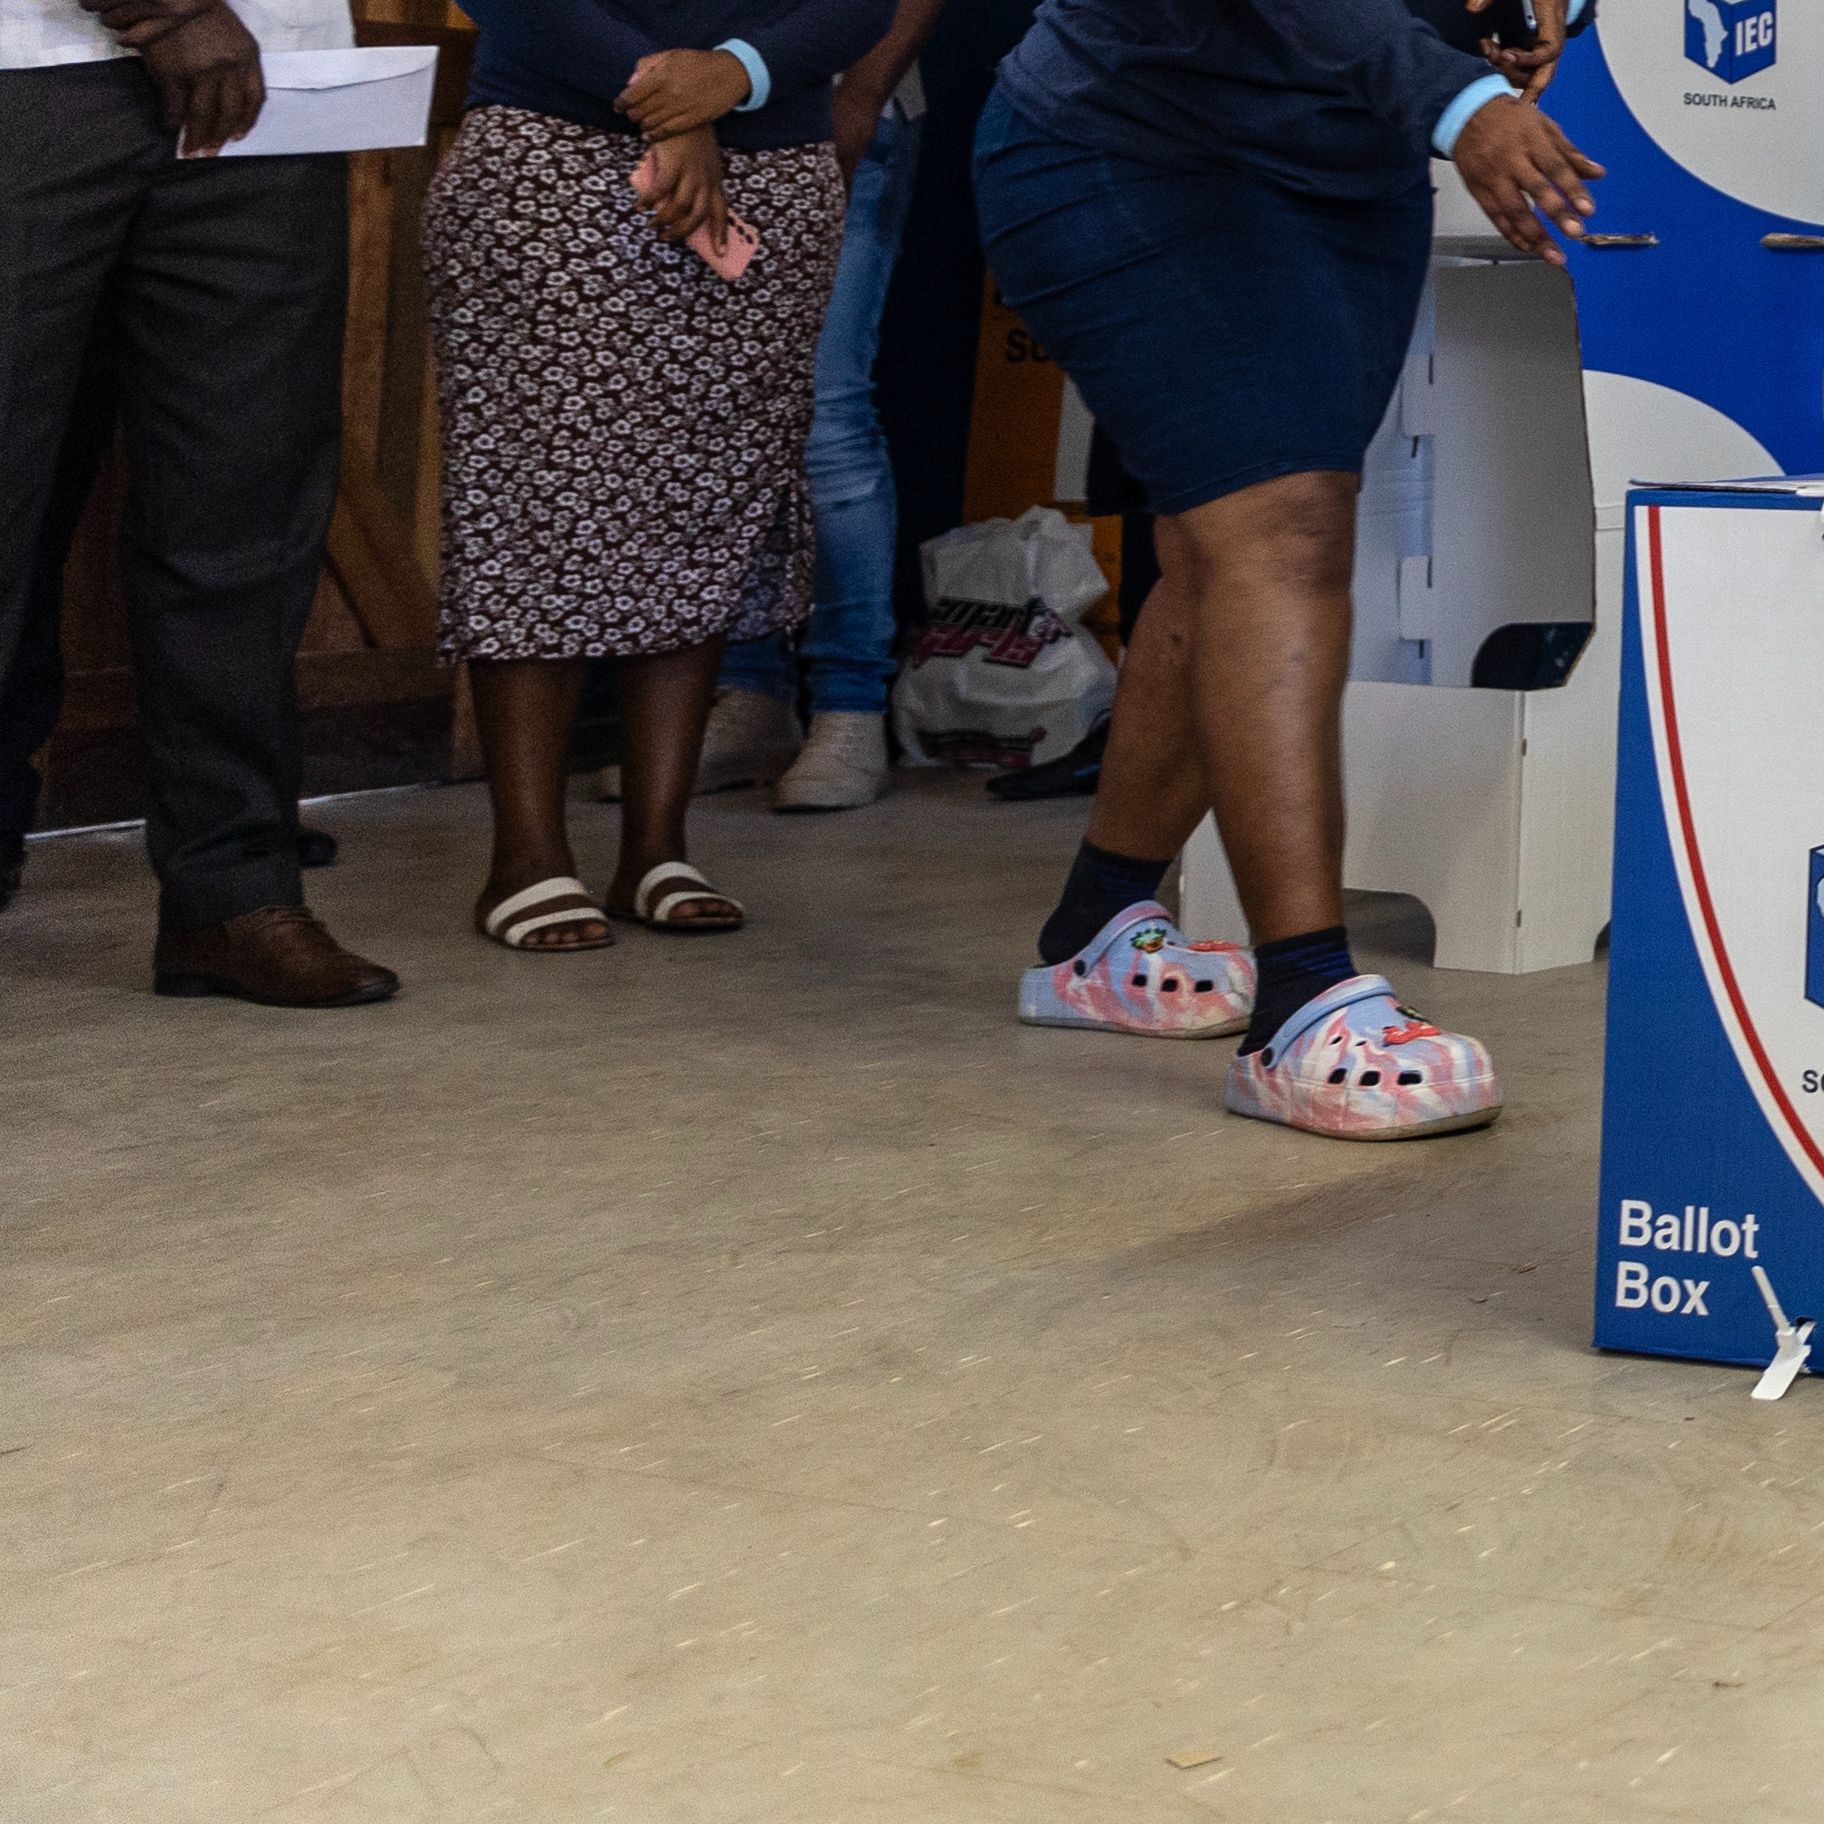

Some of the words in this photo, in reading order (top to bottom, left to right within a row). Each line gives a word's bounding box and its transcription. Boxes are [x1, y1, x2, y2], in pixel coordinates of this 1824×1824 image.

[1735, 11, 1774, 57] IEC
[1684, 92, 1728, 107] SOUTH
[1730, 95, 1776, 110] AFRICA
[1619, 1199, 1760, 1259] Ballot
[1615, 1261, 1711, 1316] Box
